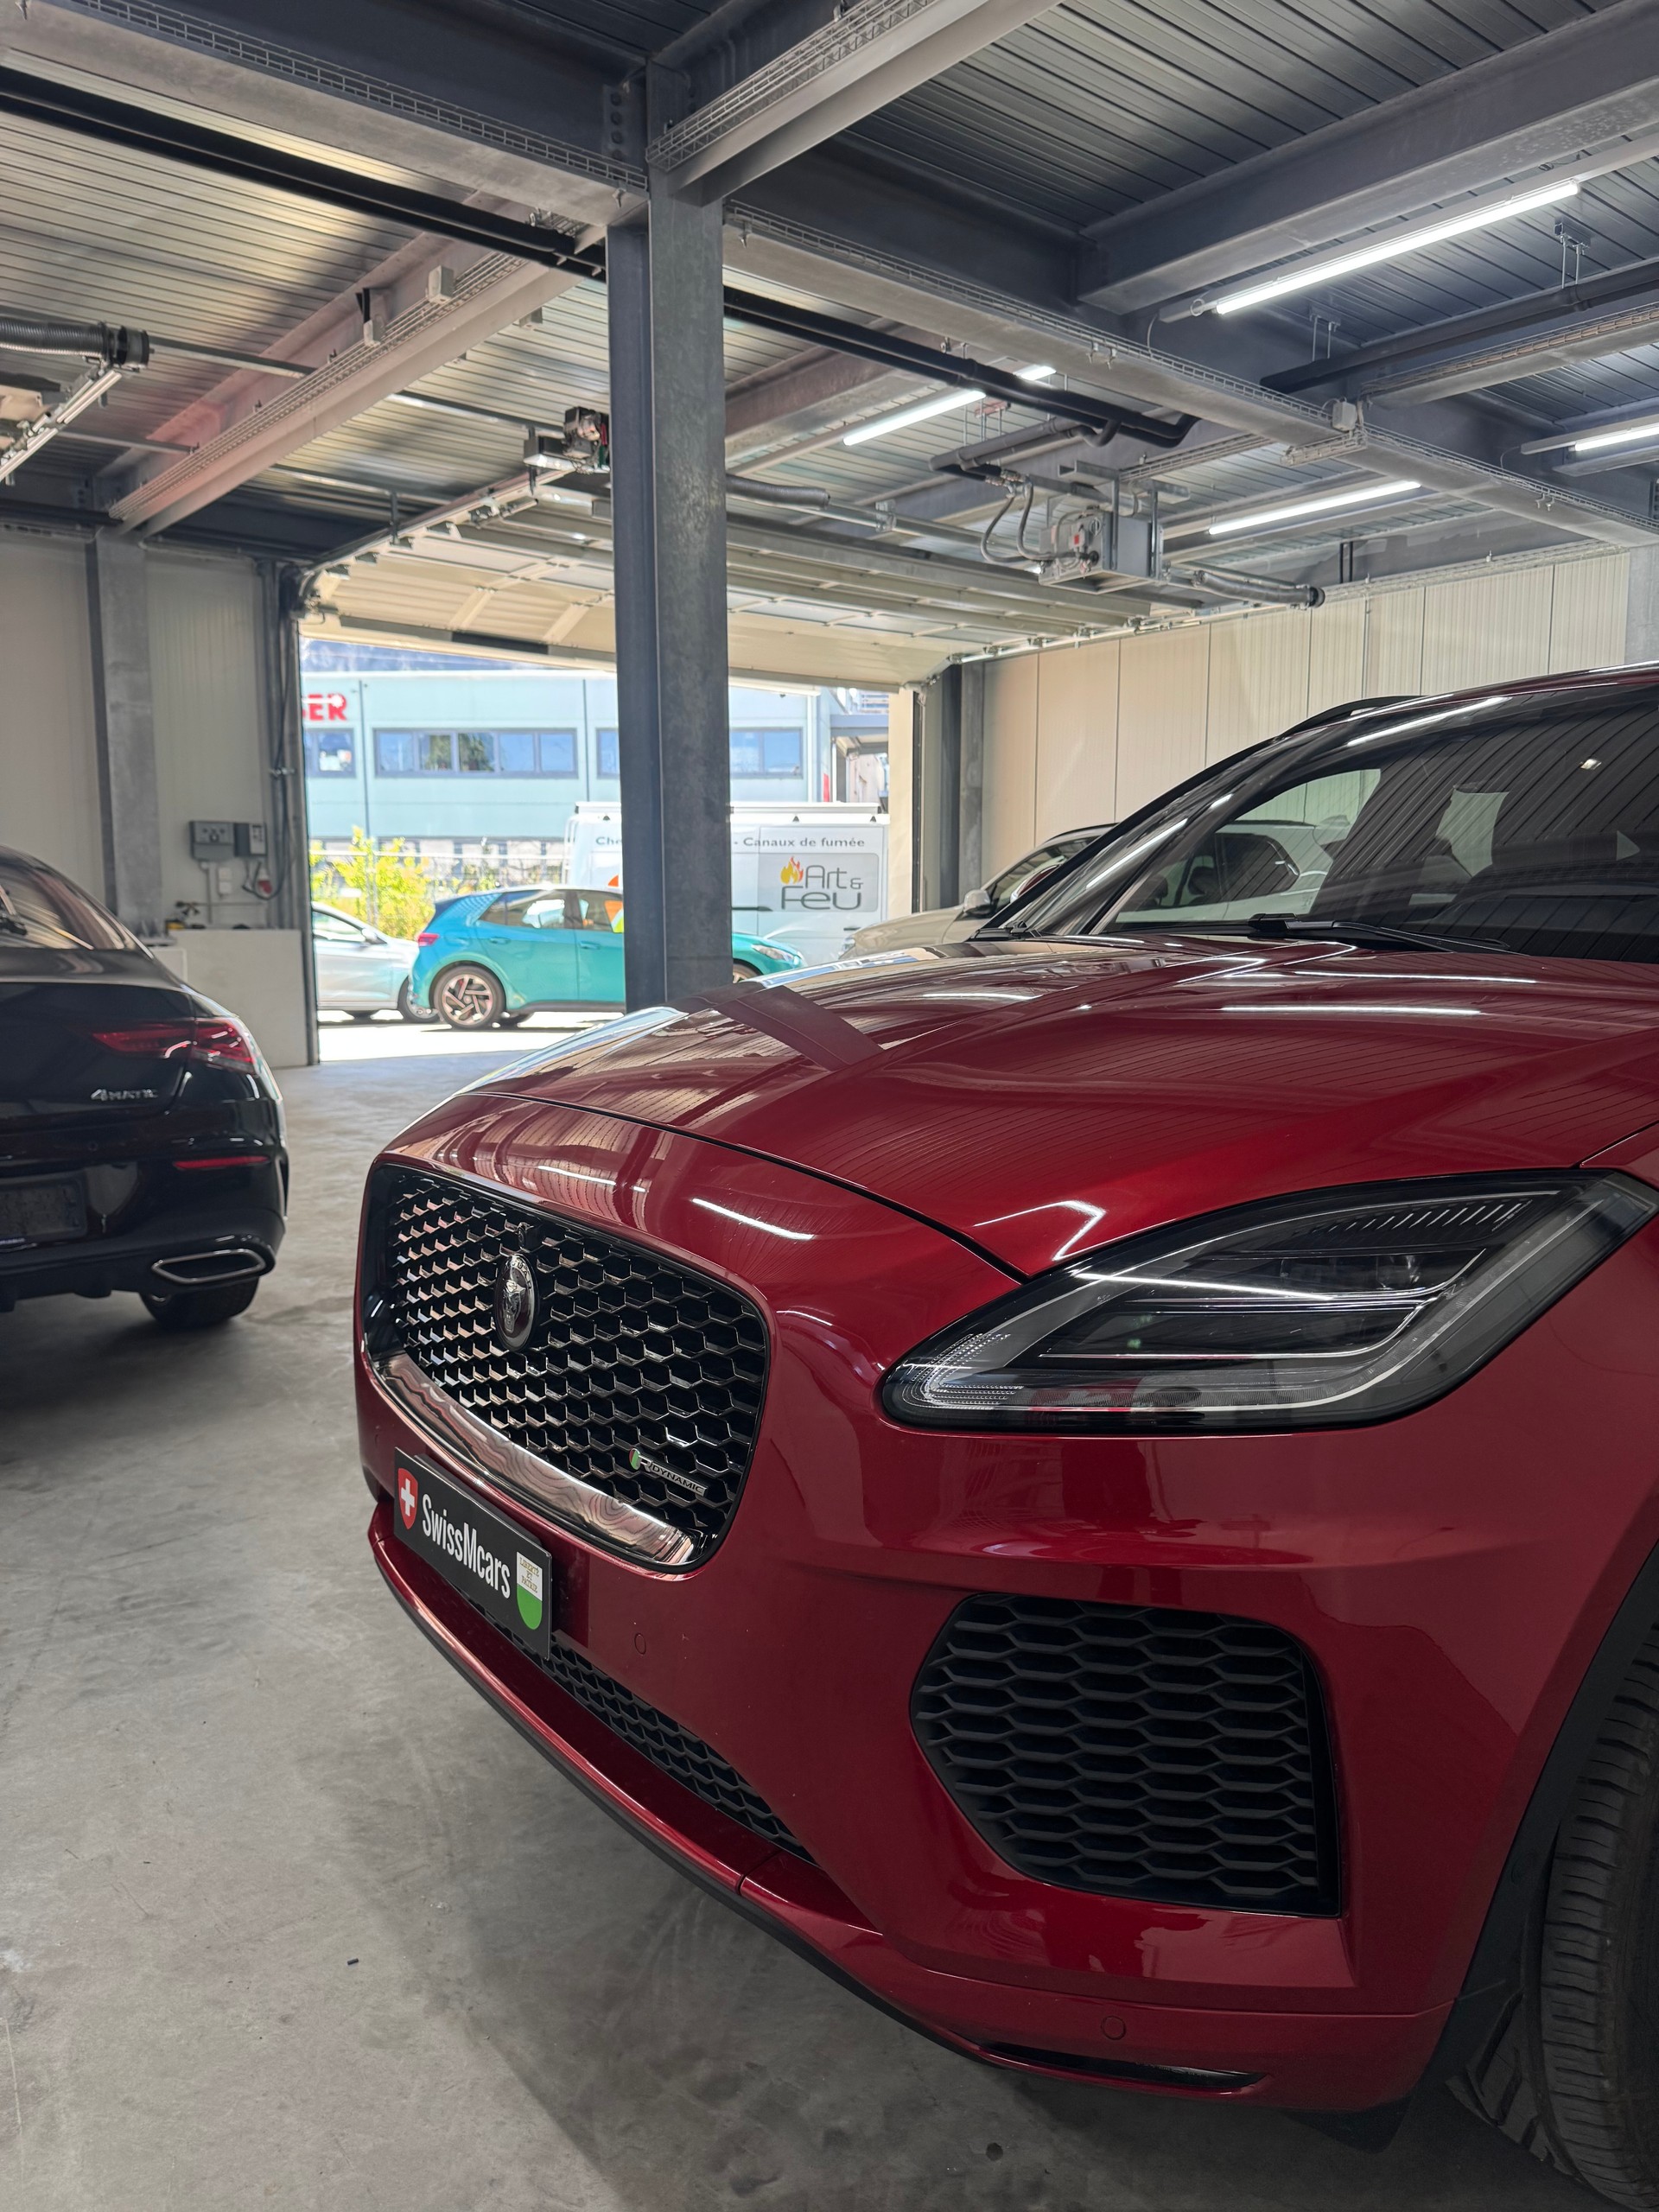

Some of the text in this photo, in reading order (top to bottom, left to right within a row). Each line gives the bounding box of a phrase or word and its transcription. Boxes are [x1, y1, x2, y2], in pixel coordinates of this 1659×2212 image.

[302, 694, 347, 721] ER
[743, 836, 795, 848] Canaux
[800, 837, 817, 847] de
[822, 836, 865, 847] fumée
[805, 865, 847, 889] Art
[422, 1493, 511, 1599] SwissMcars
